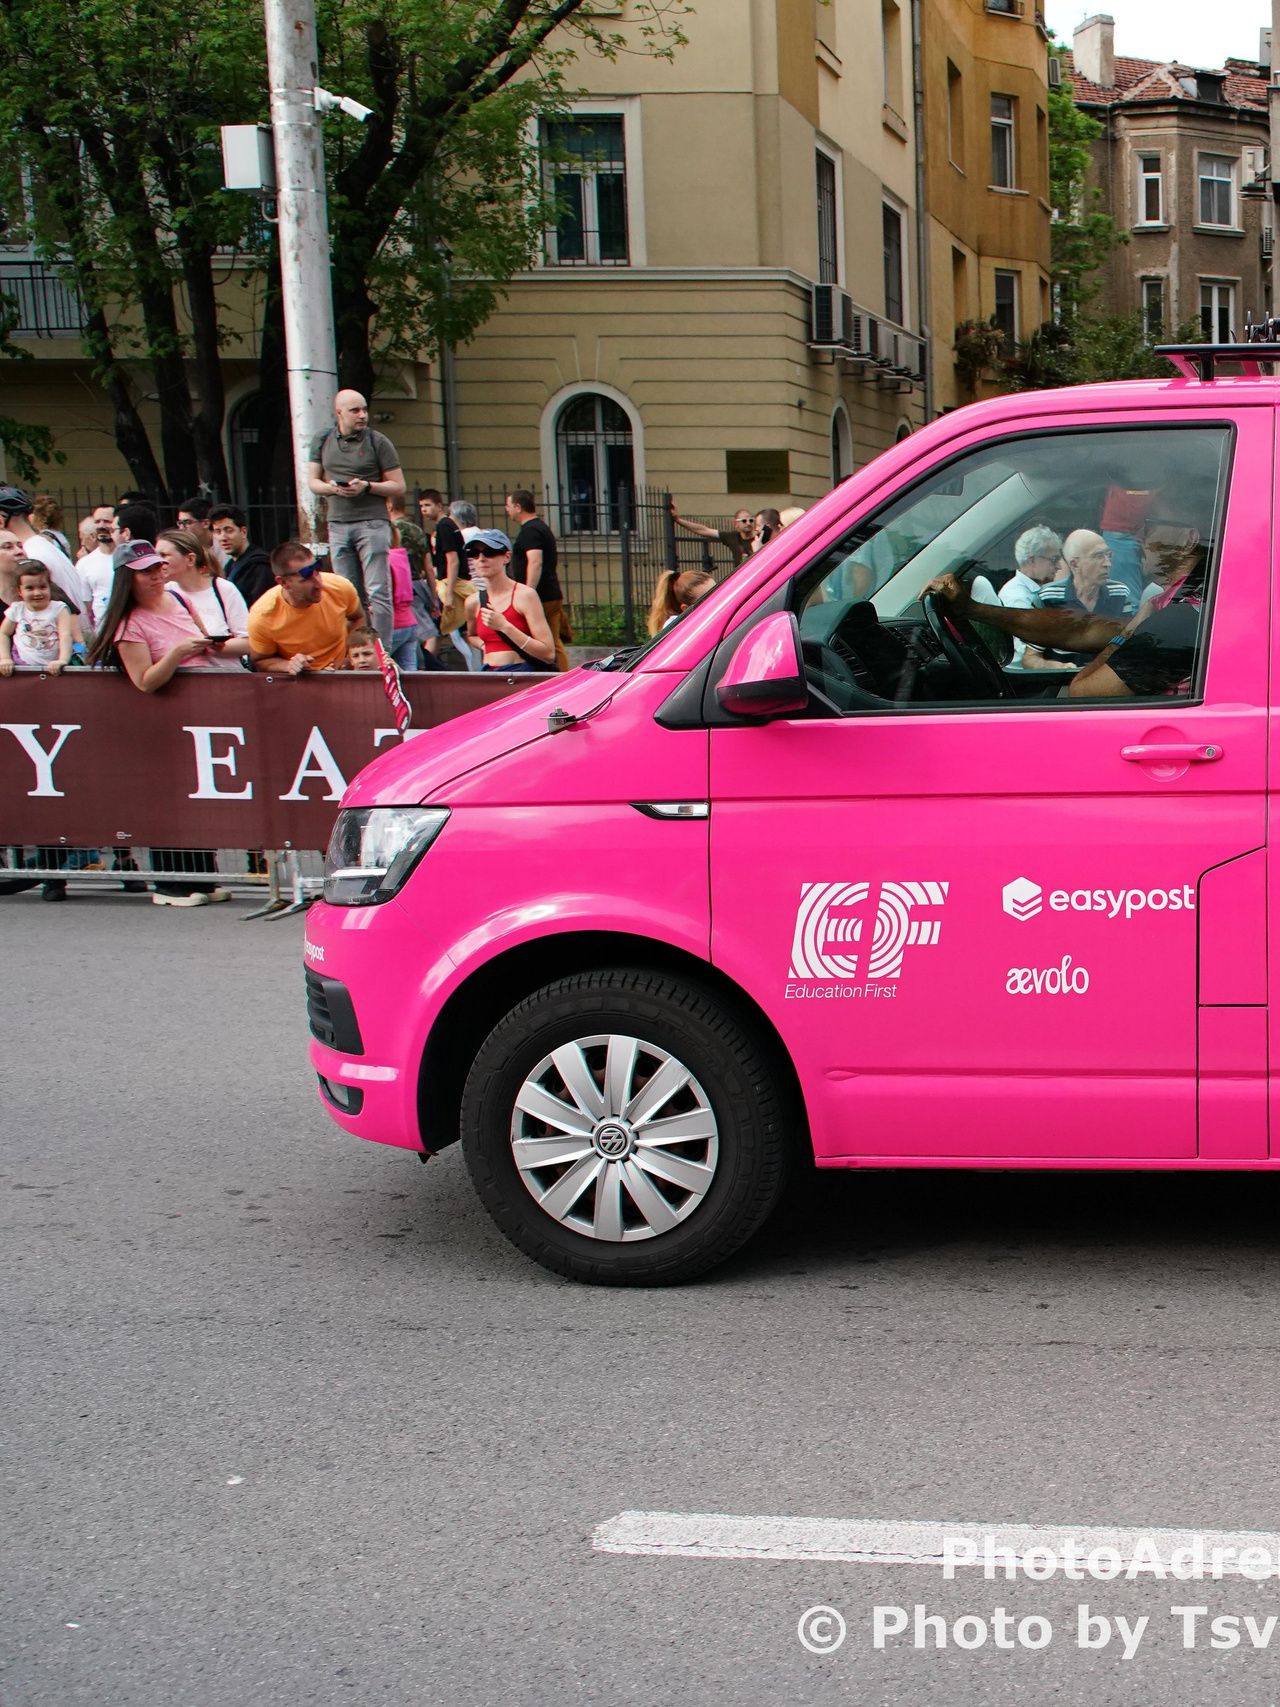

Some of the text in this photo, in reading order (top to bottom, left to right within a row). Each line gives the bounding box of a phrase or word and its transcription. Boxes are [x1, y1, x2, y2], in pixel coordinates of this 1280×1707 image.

[1049, 884, 1196, 919] easypost
[788, 881, 950, 978] EF
[785, 983, 898, 999] Education First
